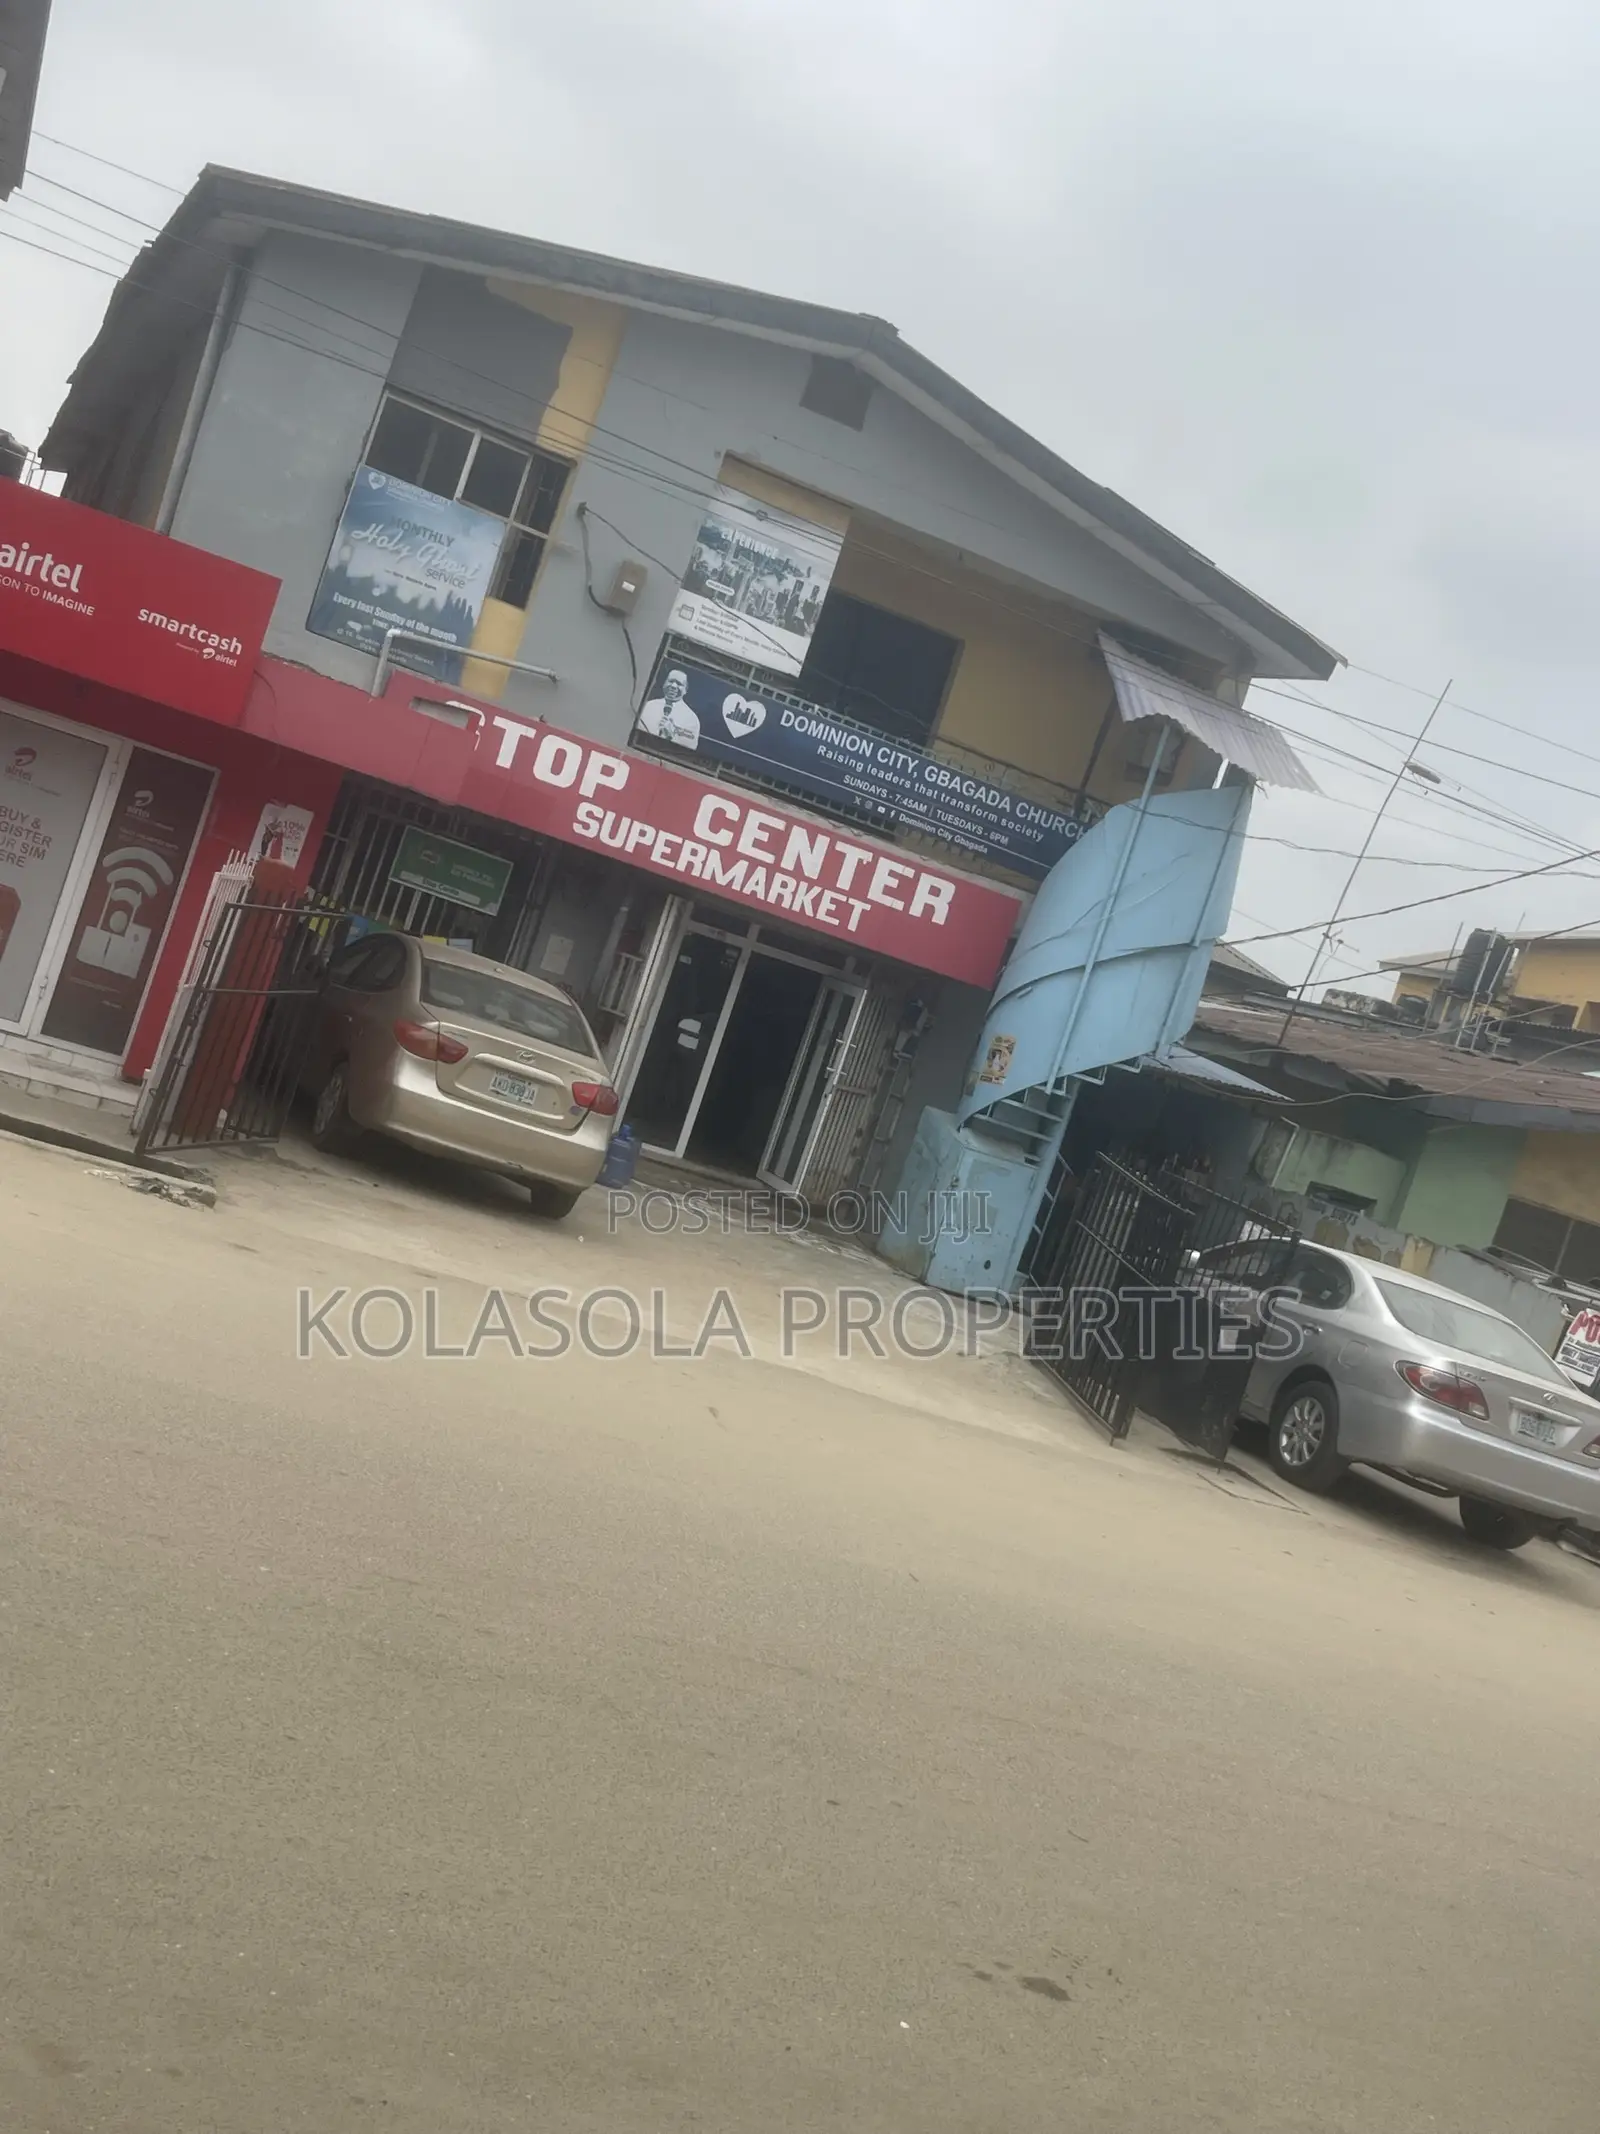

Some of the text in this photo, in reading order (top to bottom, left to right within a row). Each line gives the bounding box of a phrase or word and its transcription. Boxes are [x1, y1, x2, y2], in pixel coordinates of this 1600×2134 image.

[351, 523, 413, 564] Holy
[0, 541, 83, 593] airtel
[425, 568, 466, 589] service
[24, 582, 41, 597] TO
[42, 590, 96, 616] IMAGINE
[137, 607, 242, 655] smartcash
[214, 653, 238, 667] airtel
[780, 709, 874, 758] DOMINION
[877, 747, 919, 778] CITY,
[924, 765, 1011, 813] GBAGADA
[817, 745, 1045, 843] Raising leaders that transform society
[843, 774, 888, 798] SUNDAYS
[936, 809, 984, 836] TUESDAYS
[989, 831, 1010, 847] 6PM
[0, 805, 42, 830] BUY &
[898, 813, 988, 855] Dominion City Gbagada
[20, 842, 47, 861] SIM
[572, 801, 871, 933] SUPERMARKET
[692, 793, 956, 926] CENTER
